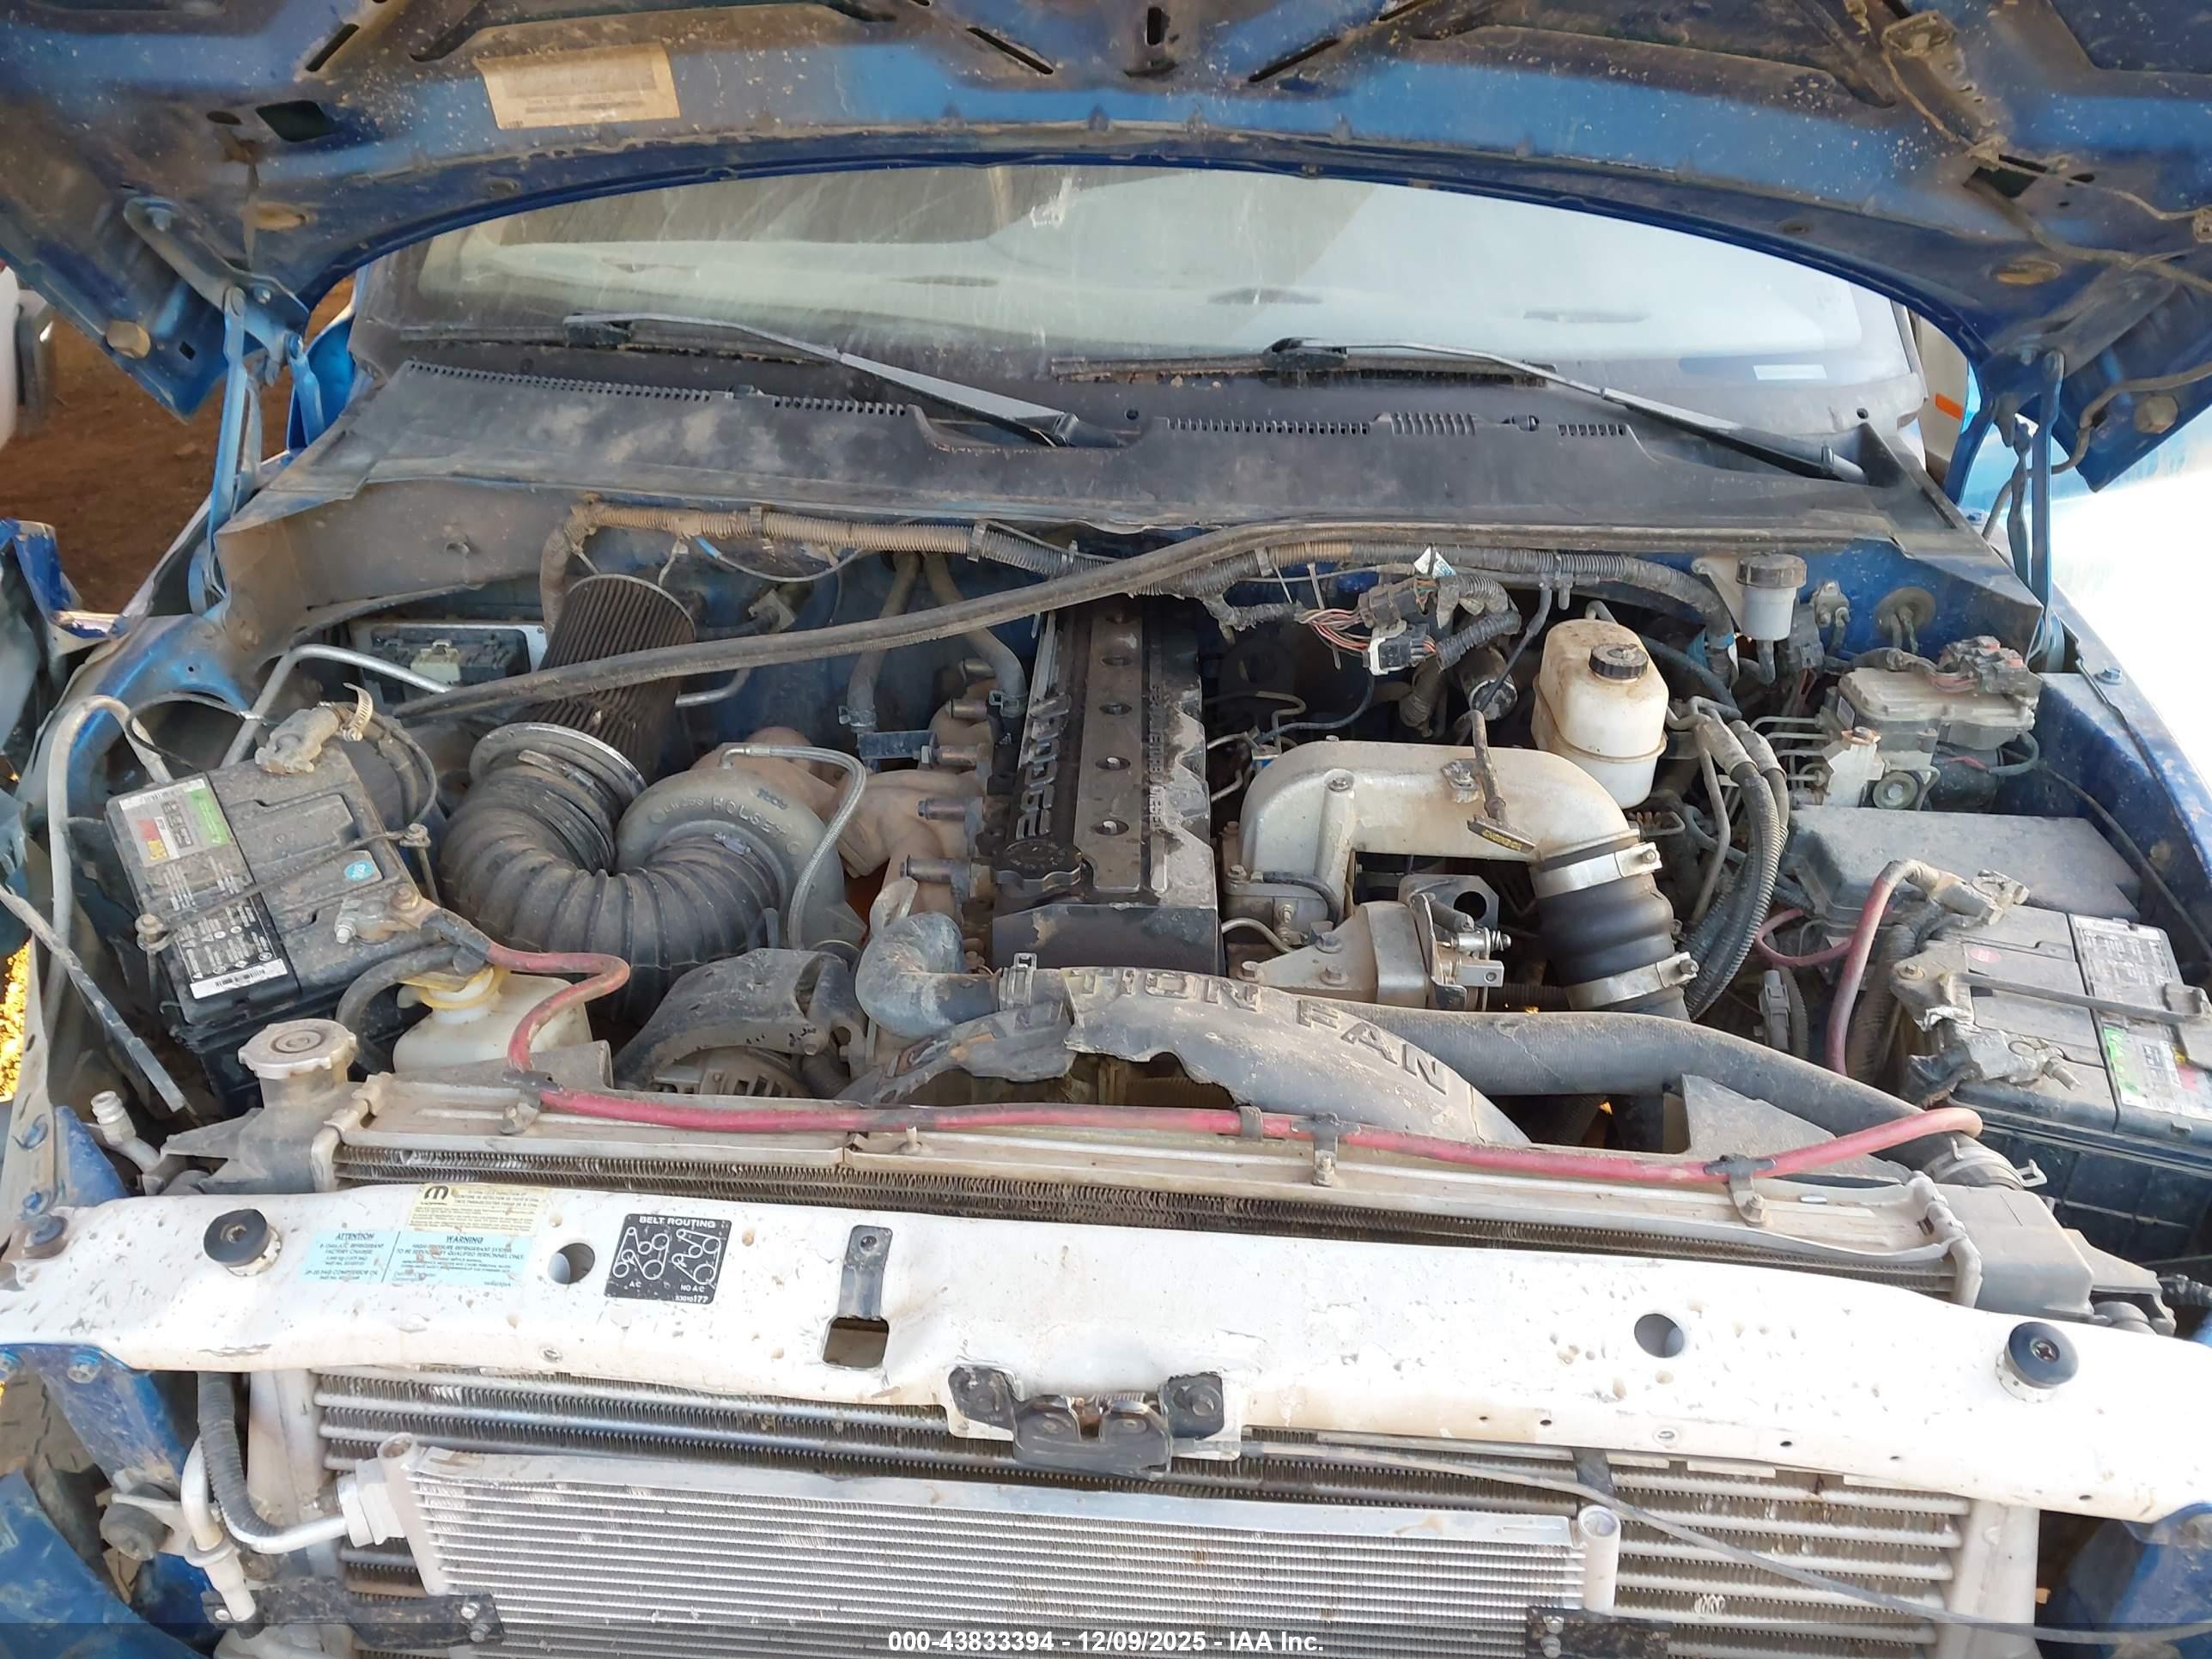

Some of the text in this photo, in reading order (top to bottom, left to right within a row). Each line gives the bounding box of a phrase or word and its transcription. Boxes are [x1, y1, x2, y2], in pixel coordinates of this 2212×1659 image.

[711, 796, 789, 837] HOLSET
[1295, 998, 1450, 1097] FAN
[639, 1215, 716, 1229] BELT ROUTING
[335, 1232, 374, 1241] ATTENTION
[446, 1235, 484, 1244] WARNING
